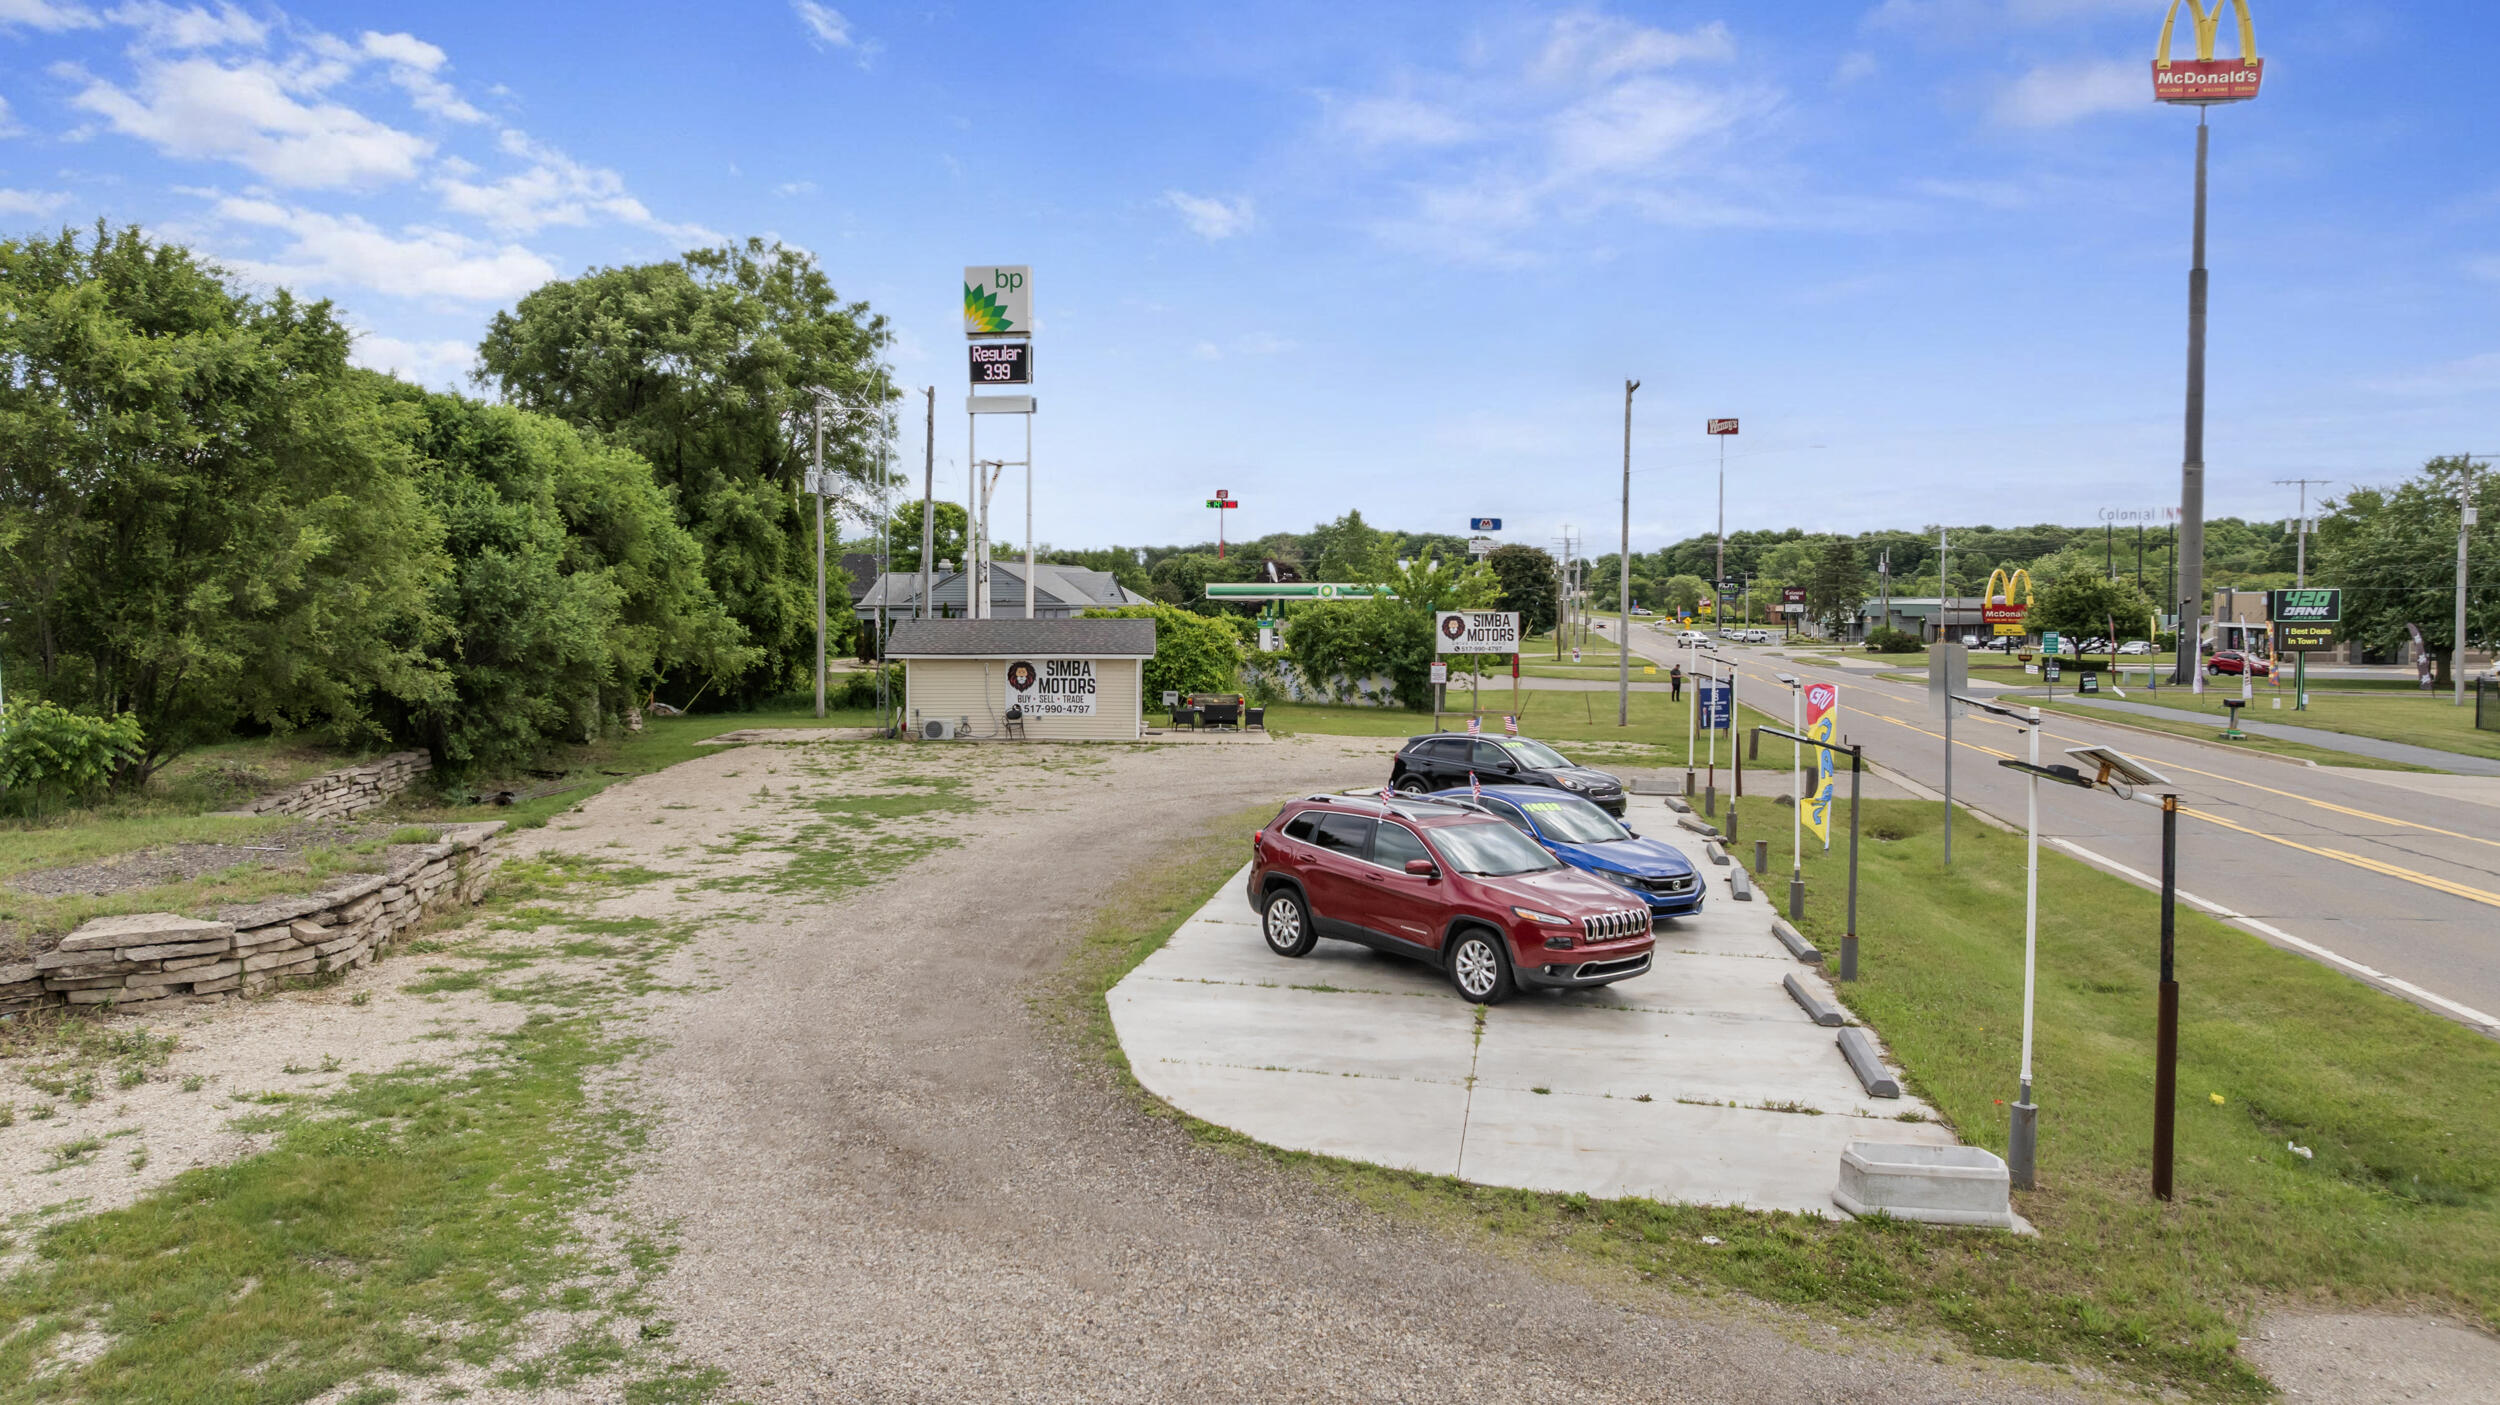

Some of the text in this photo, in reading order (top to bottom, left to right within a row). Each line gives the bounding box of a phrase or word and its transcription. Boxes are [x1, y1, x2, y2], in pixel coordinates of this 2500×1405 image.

[2158, 71, 2257, 84] McDonald's
[995, 268, 1023, 293] bp
[973, 345, 1022, 362] Regular
[984, 364, 1010, 380] 3.99
[2098, 507, 2155, 520] Colonial
[2285, 591, 2332, 606] 420
[2283, 607, 2330, 615] DANK
[1473, 614, 1510, 627] SIMBA
[1467, 628, 1514, 641] MOTORS
[1046, 661, 1091, 676] SIMBA
[1039, 678, 1096, 694] MOTORS
[1017, 695, 1084, 703] BUY SELL TRADE
[1024, 705, 1090, 713] 517-990-4797
